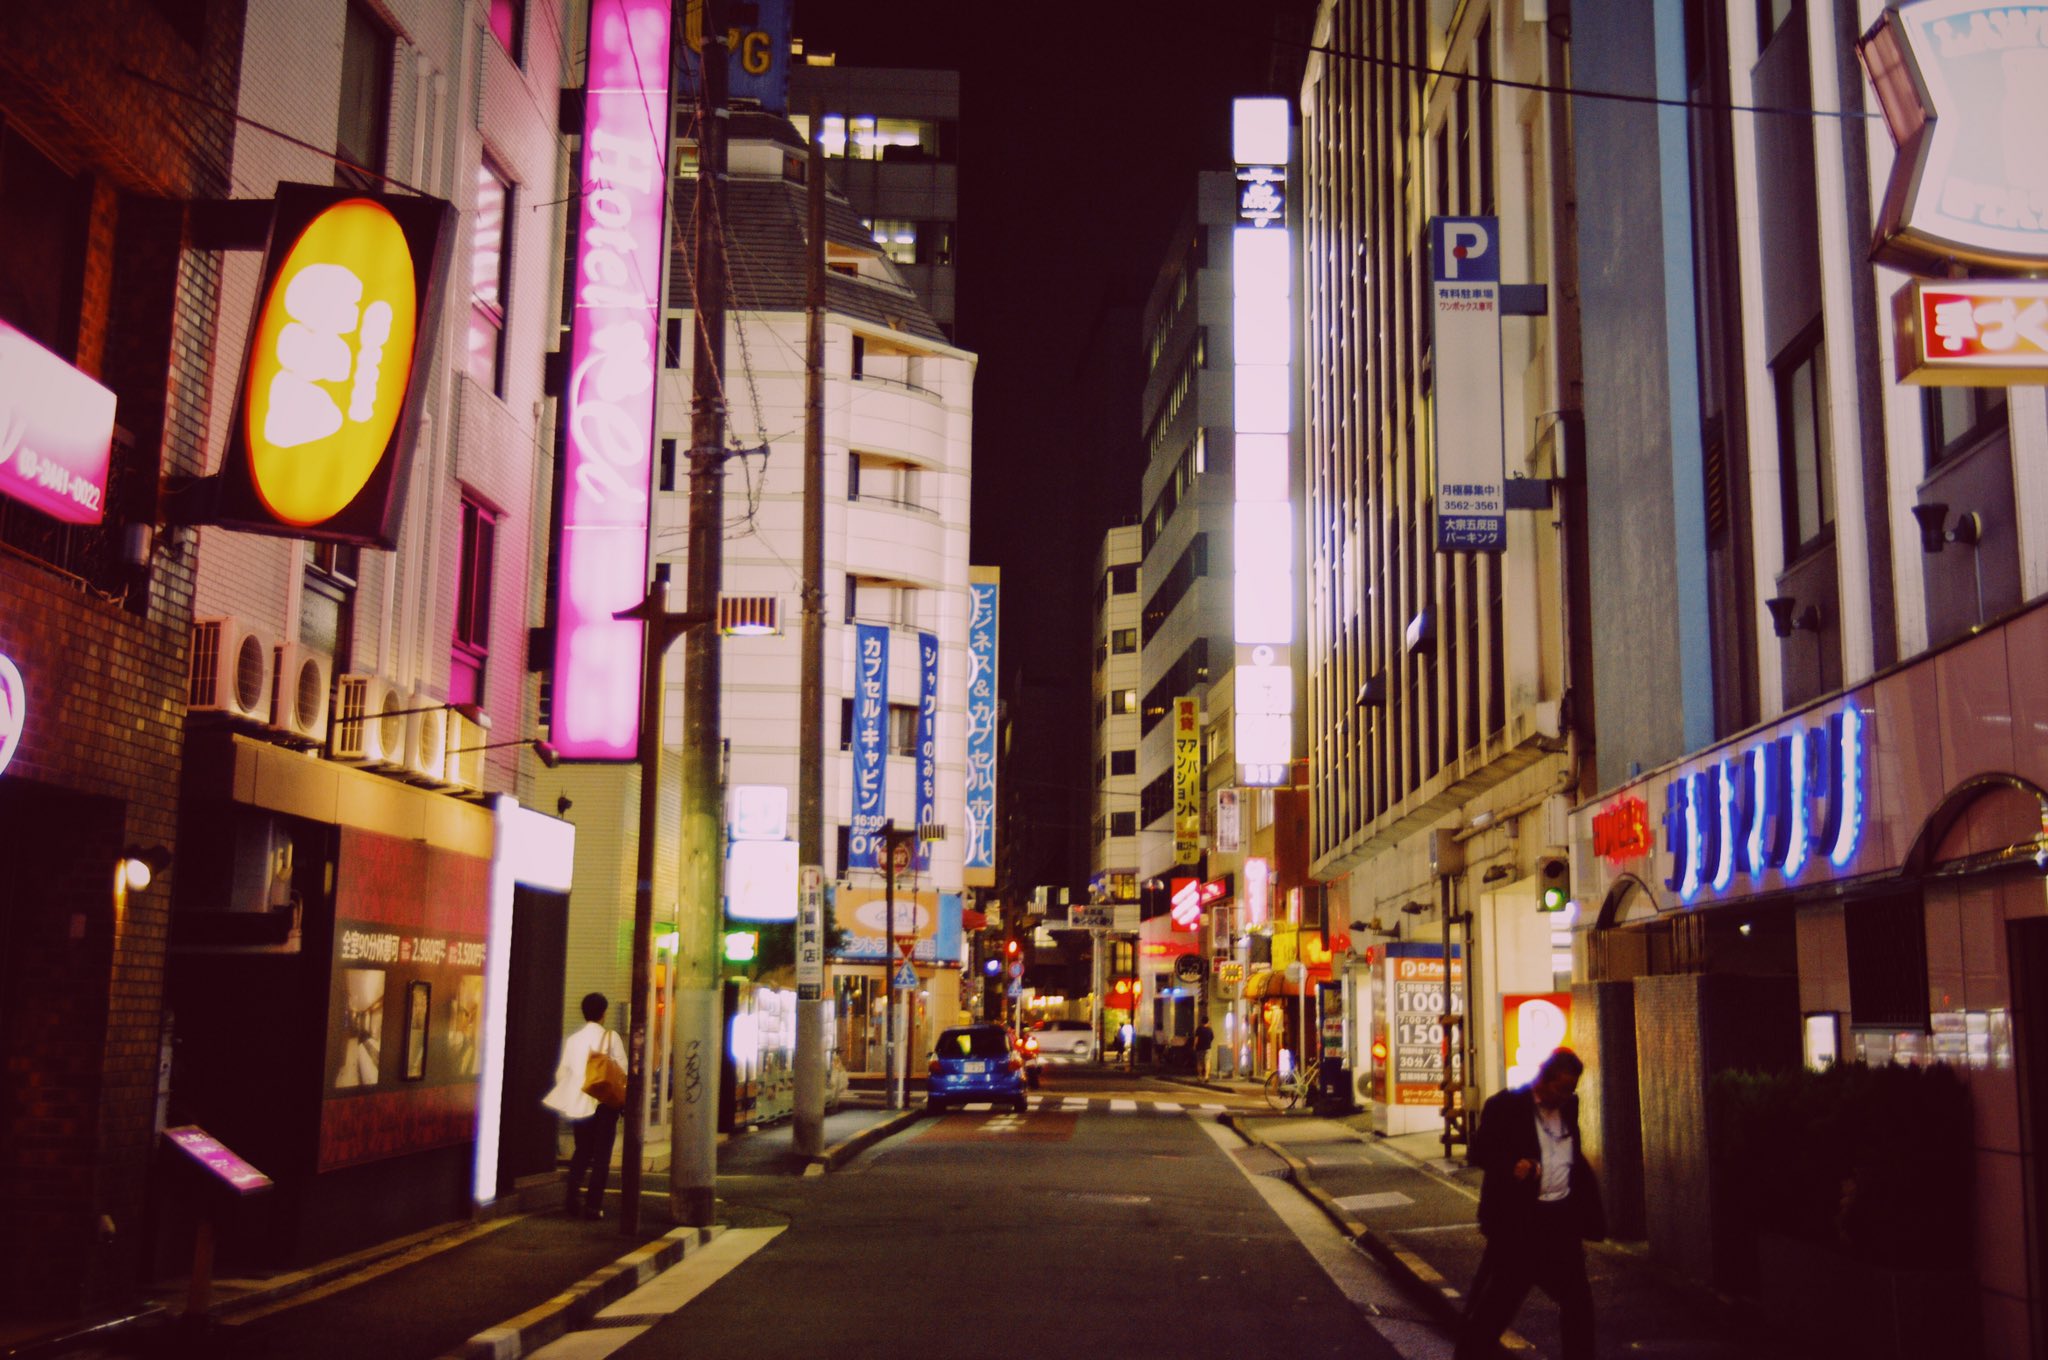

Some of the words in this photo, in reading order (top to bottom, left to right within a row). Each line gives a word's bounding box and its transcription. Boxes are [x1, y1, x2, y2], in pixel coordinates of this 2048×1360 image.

[583, 129, 653, 309] Hotel
[1443, 222, 1488, 278] P
[1439, 289, 1493, 299] 有料駐車場
[1444, 501, 1498, 510] 3562-3561
[1445, 532, 1498, 544] パーキング
[1176, 739, 1186, 816] マンション
[1187, 739, 1198, 816] アパート
[854, 814, 884, 827] 16:00
